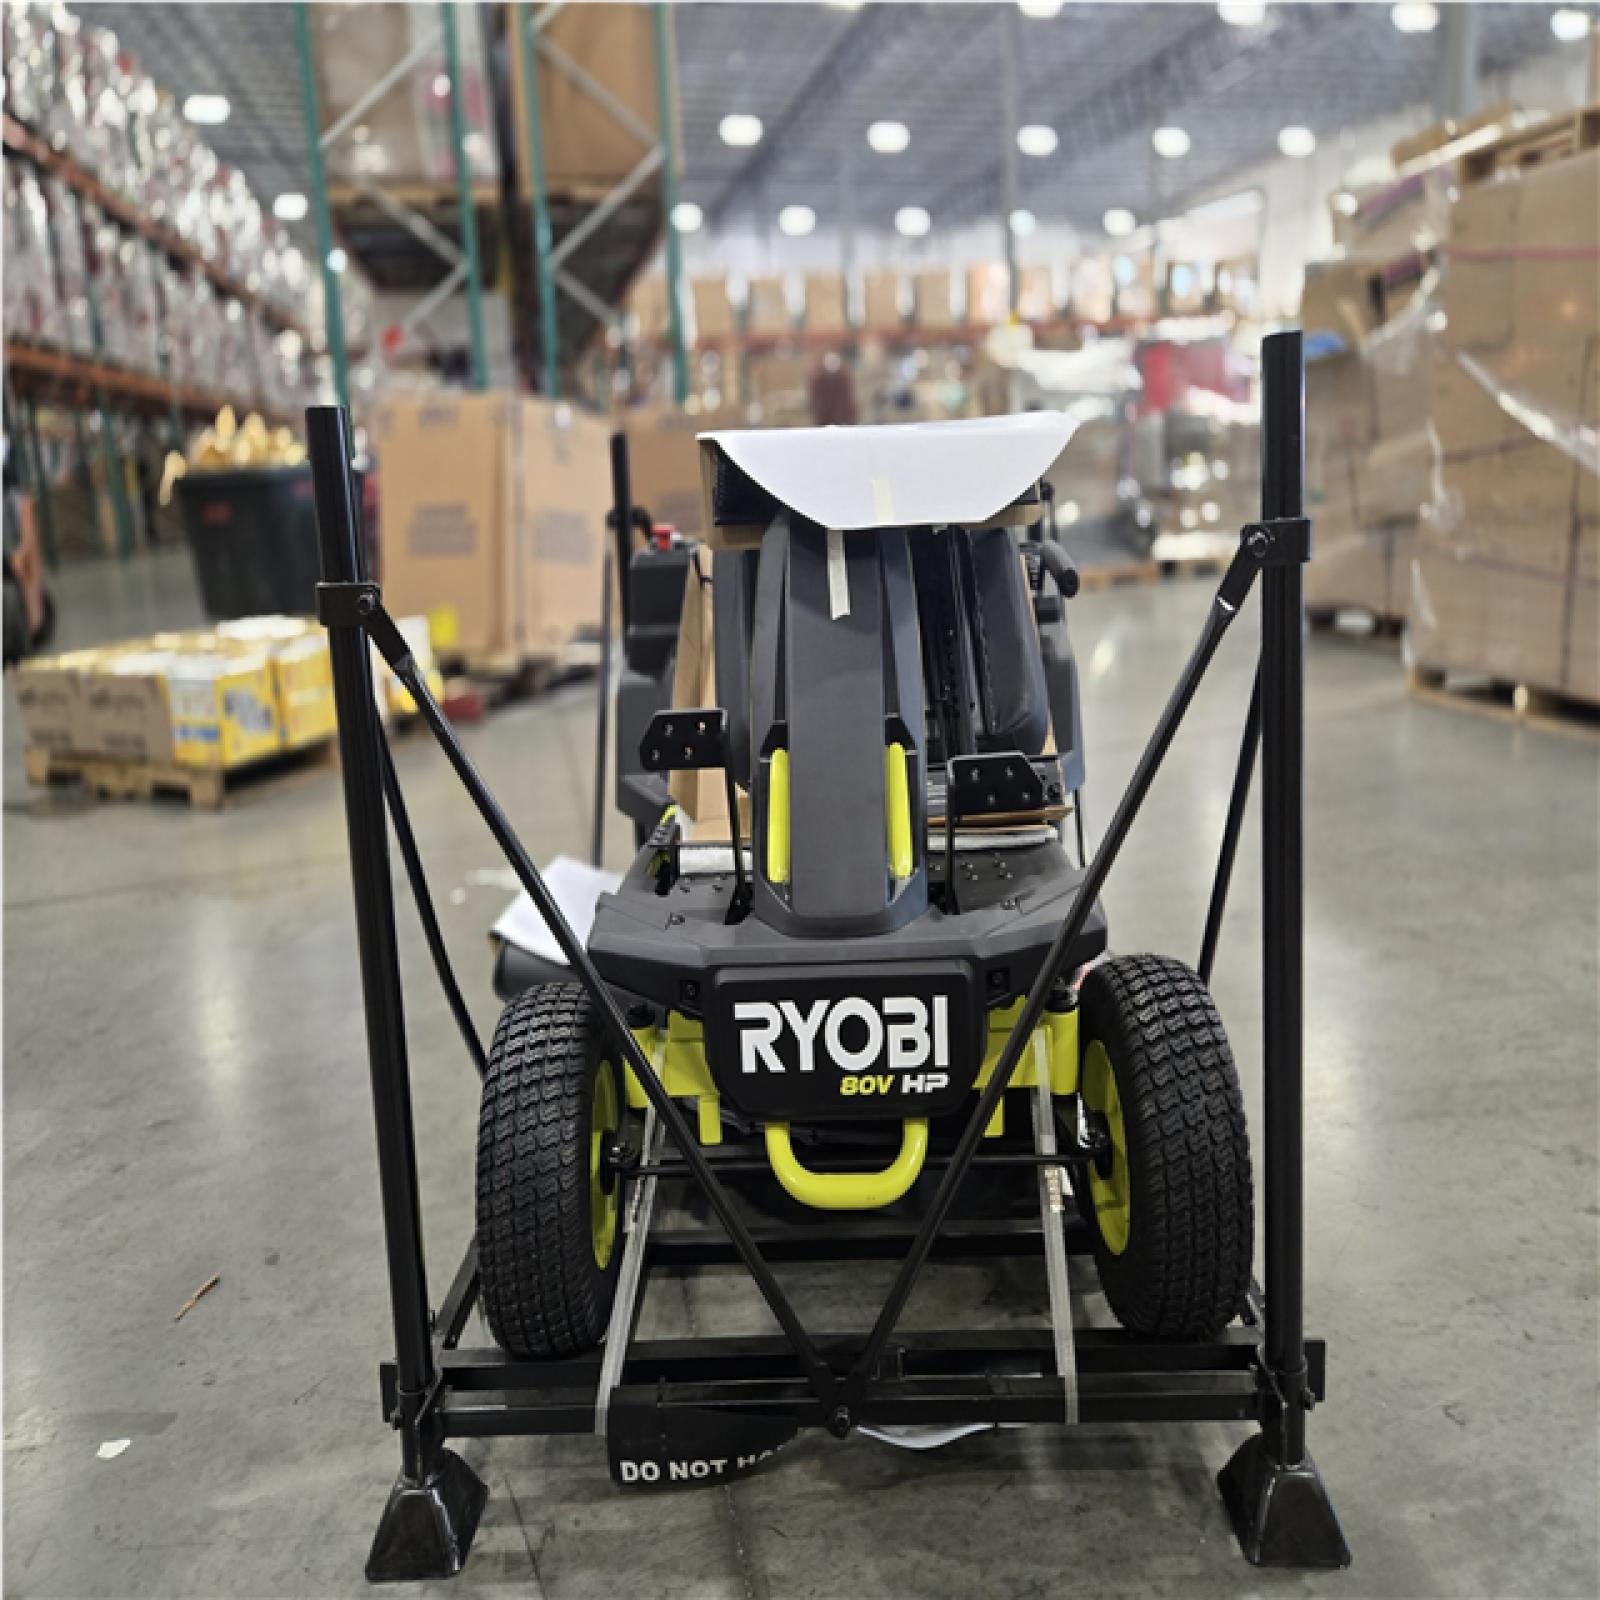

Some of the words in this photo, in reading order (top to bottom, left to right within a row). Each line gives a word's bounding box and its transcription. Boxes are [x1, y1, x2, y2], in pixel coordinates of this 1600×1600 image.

[734, 995, 949, 1073] RYOBI
[840, 1075, 895, 1095] 80V
[901, 1073, 949, 1093] HP
[620, 1460, 661, 1481] DO
[670, 1459, 729, 1480] NOT
